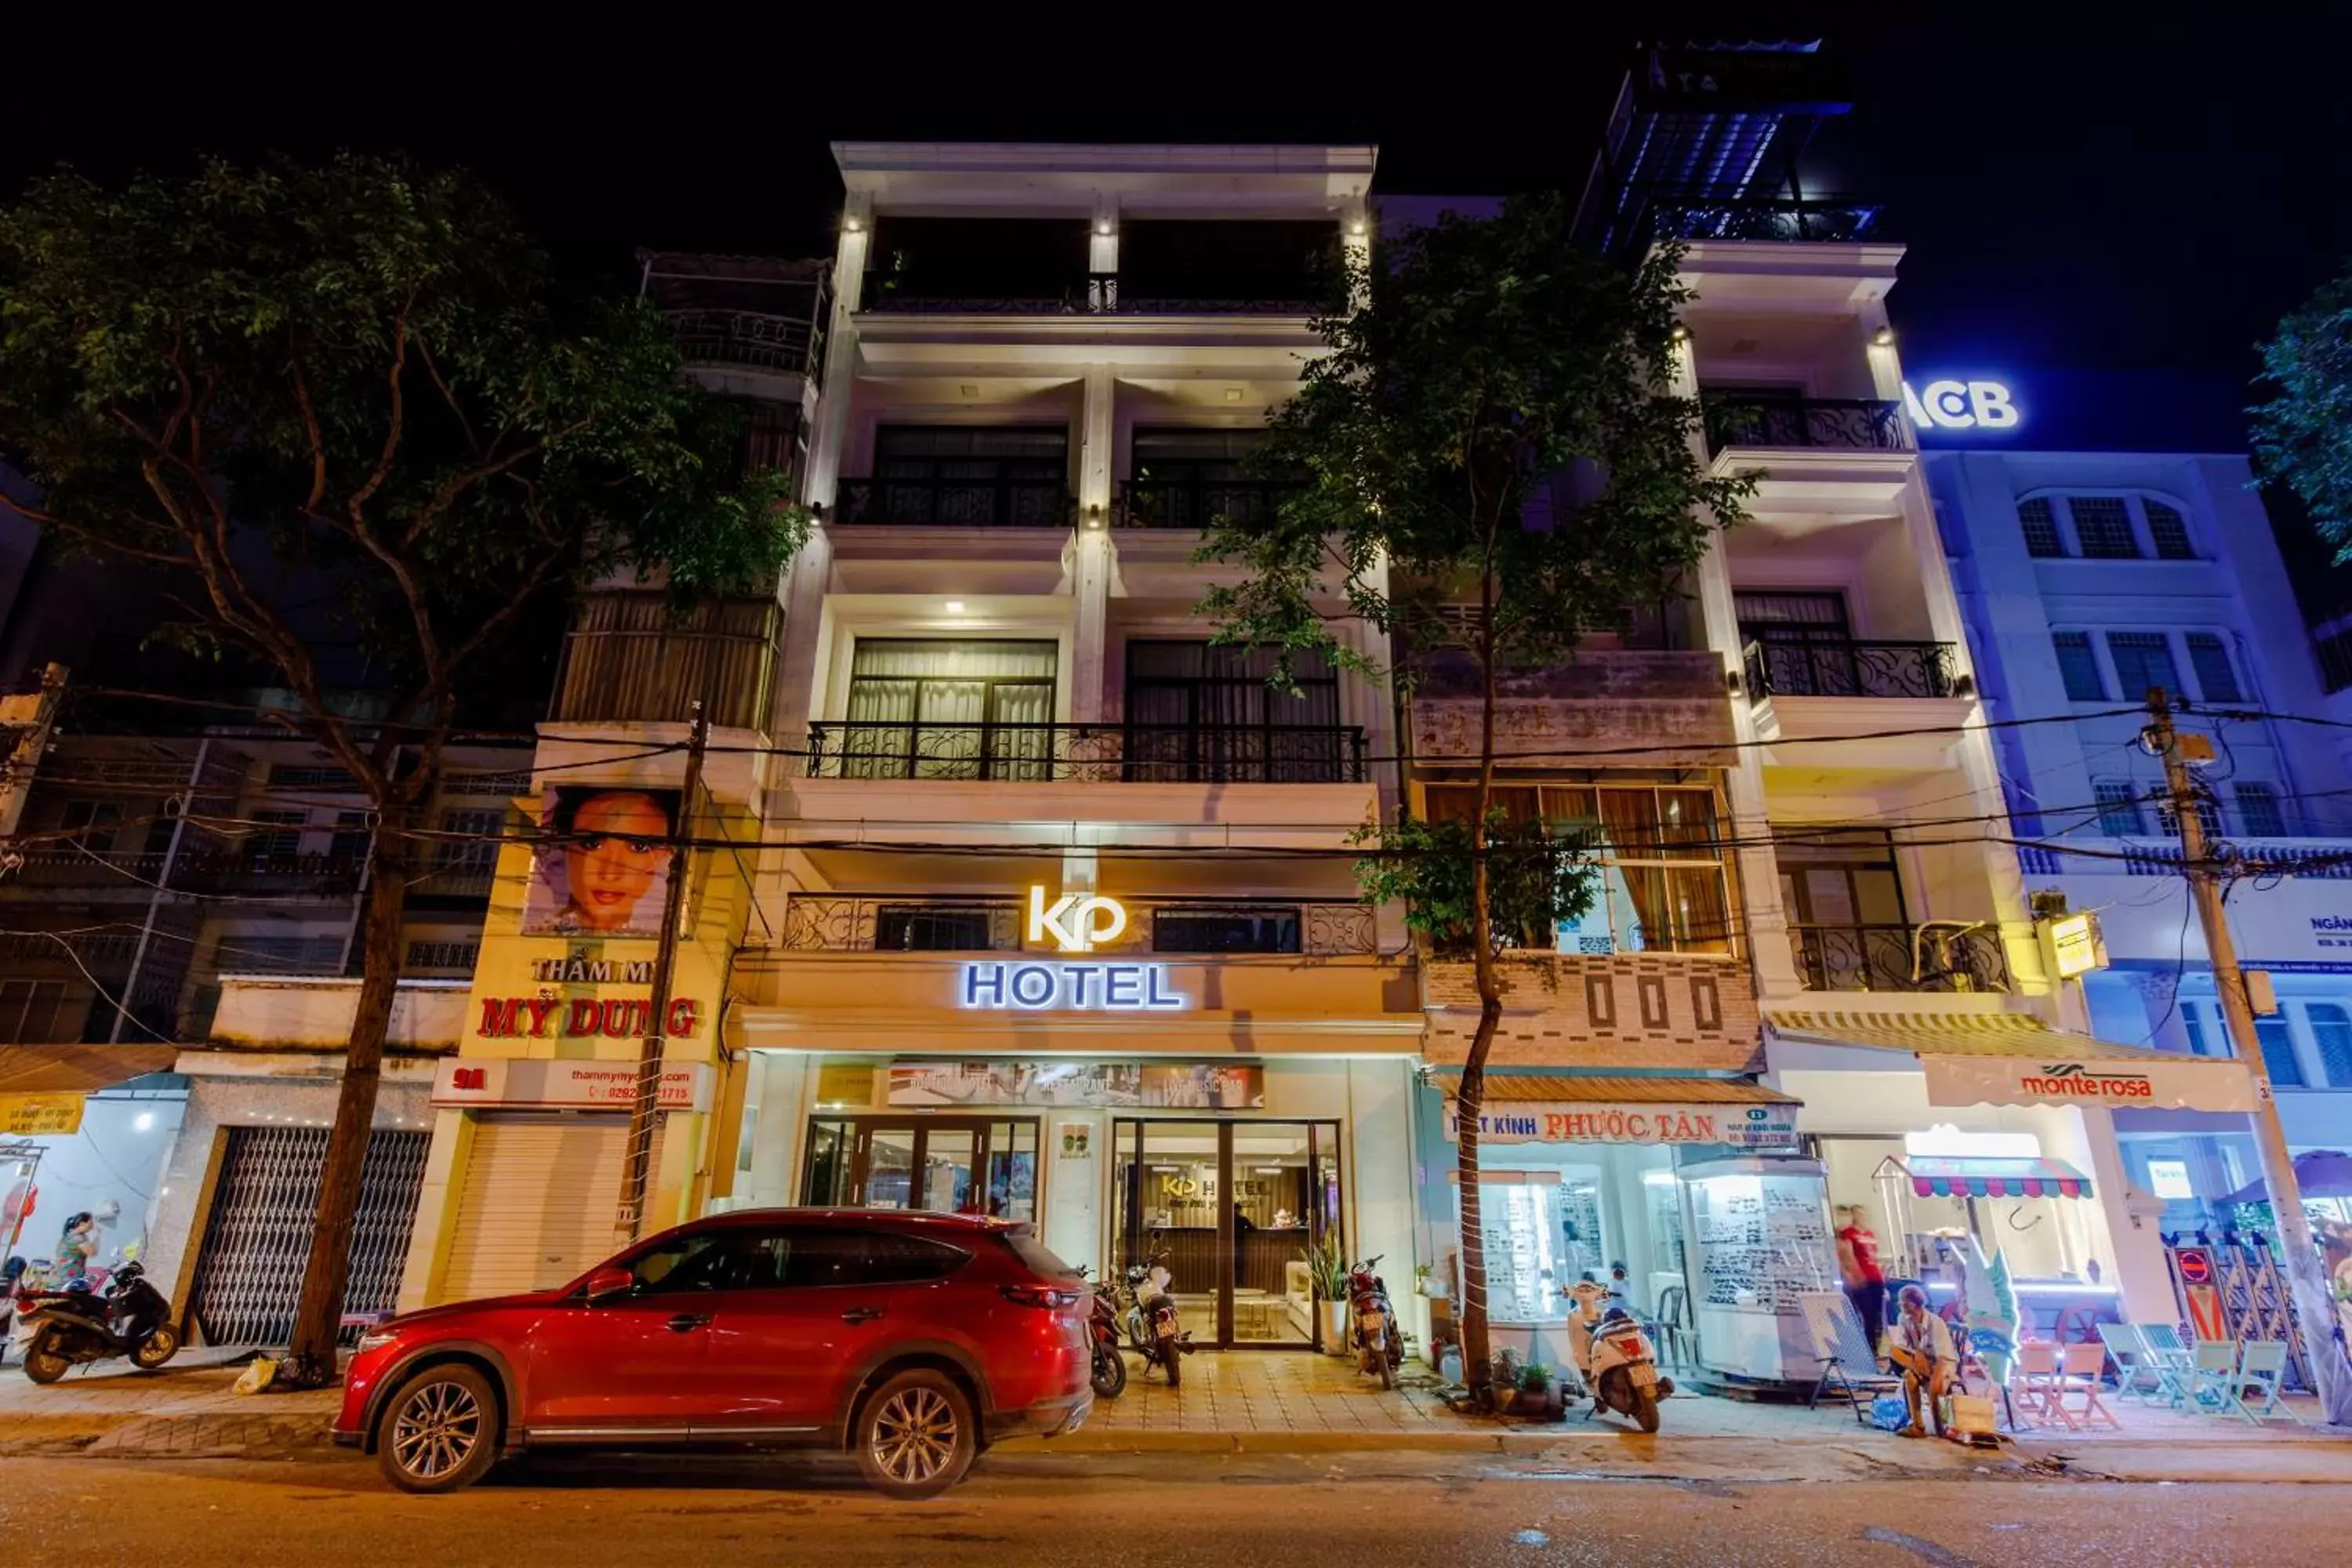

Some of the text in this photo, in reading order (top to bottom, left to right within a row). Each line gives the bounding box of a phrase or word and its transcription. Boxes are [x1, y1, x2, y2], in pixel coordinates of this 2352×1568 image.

[966, 964, 1182, 1007] HOTEL
[452, 1068, 485, 1089] 9A
[2021, 1073, 2151, 1096] monte rosa
[1201, 1180, 1270, 1196] HTEL
